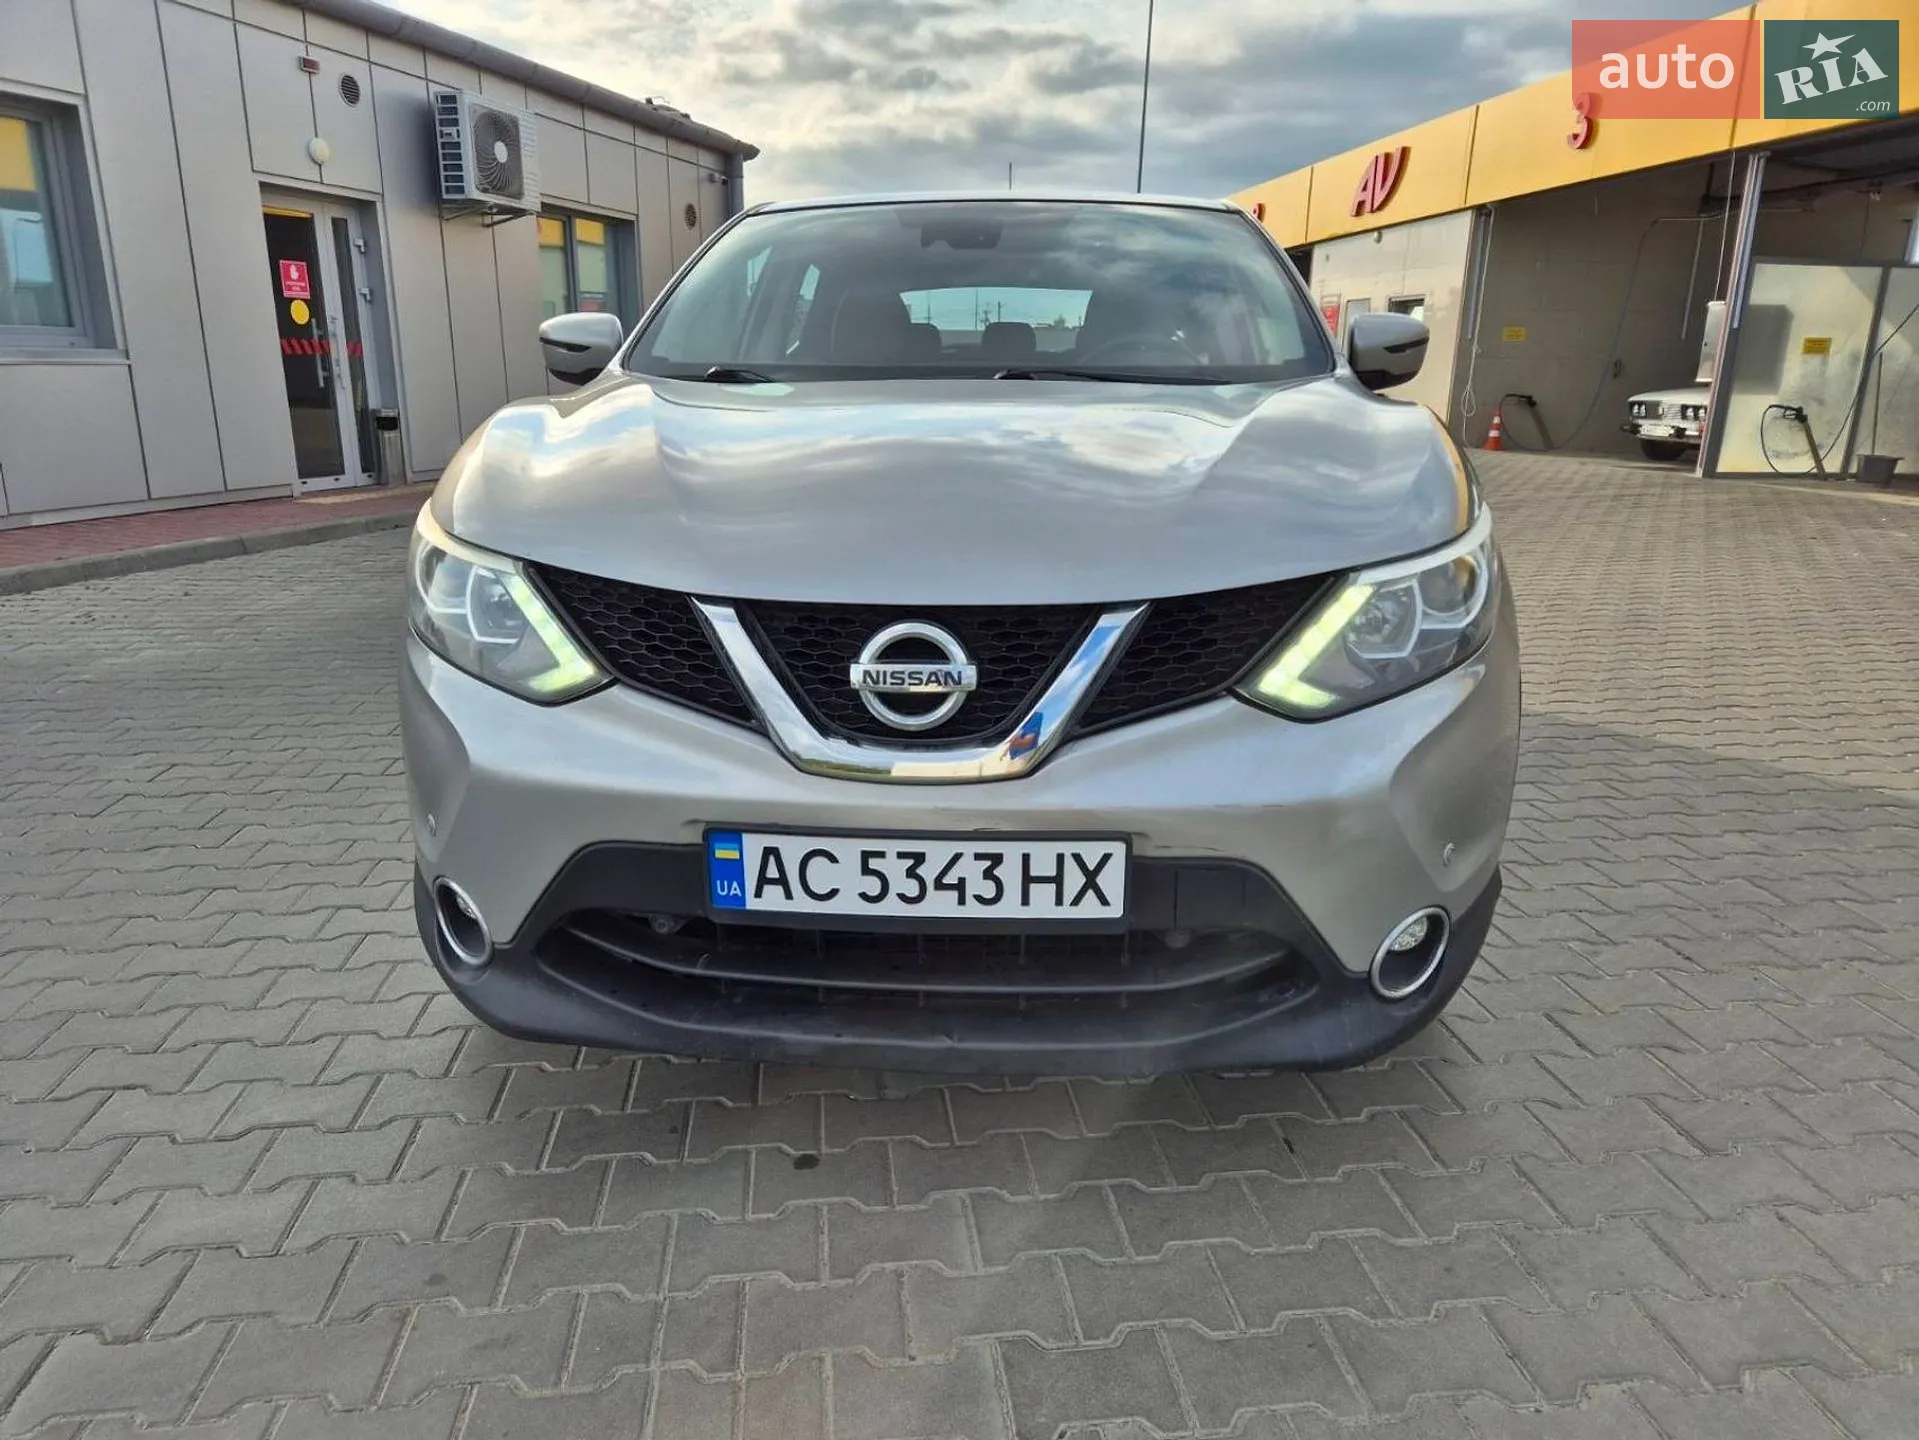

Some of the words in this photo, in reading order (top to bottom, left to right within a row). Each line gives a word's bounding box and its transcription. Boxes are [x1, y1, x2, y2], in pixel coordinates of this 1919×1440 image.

[1567, 92, 1595, 150] 3
[862, 669, 962, 686] NISSAN
[716, 879, 742, 897] UA
[753, 846, 840, 902] AC
[857, 849, 1005, 906] 5343
[1020, 852, 1113, 907] HX
